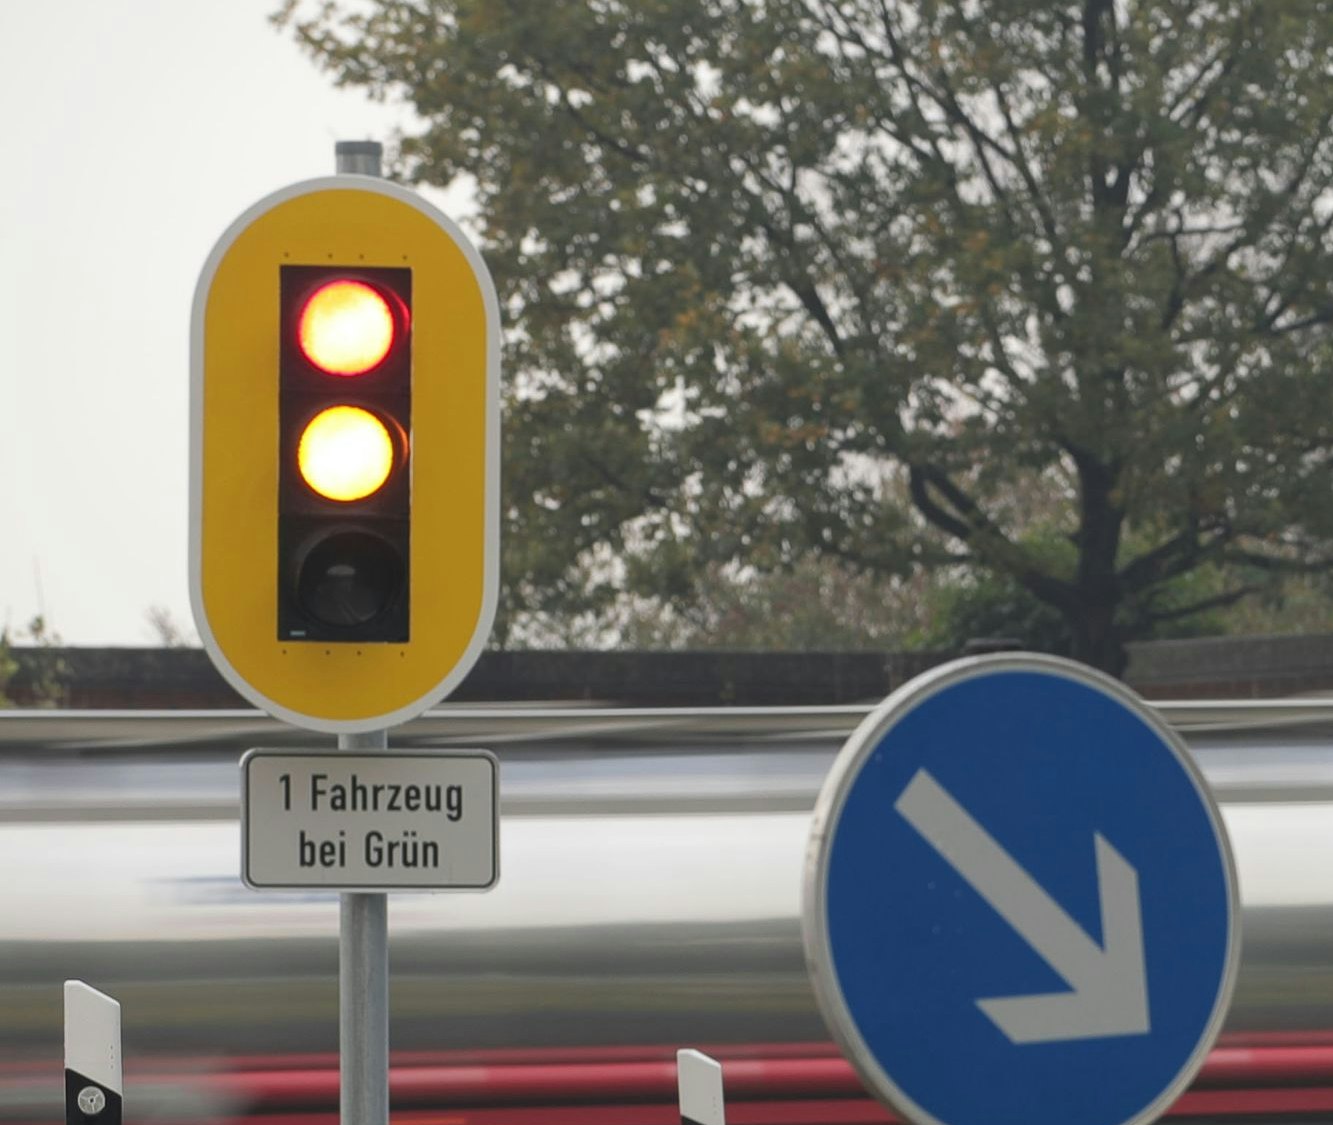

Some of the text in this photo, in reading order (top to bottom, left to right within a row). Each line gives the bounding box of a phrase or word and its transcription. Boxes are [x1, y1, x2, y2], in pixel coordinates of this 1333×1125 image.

[279, 773, 463, 822] 1 Fahrzeug
[299, 830, 439, 868] bei Grün
